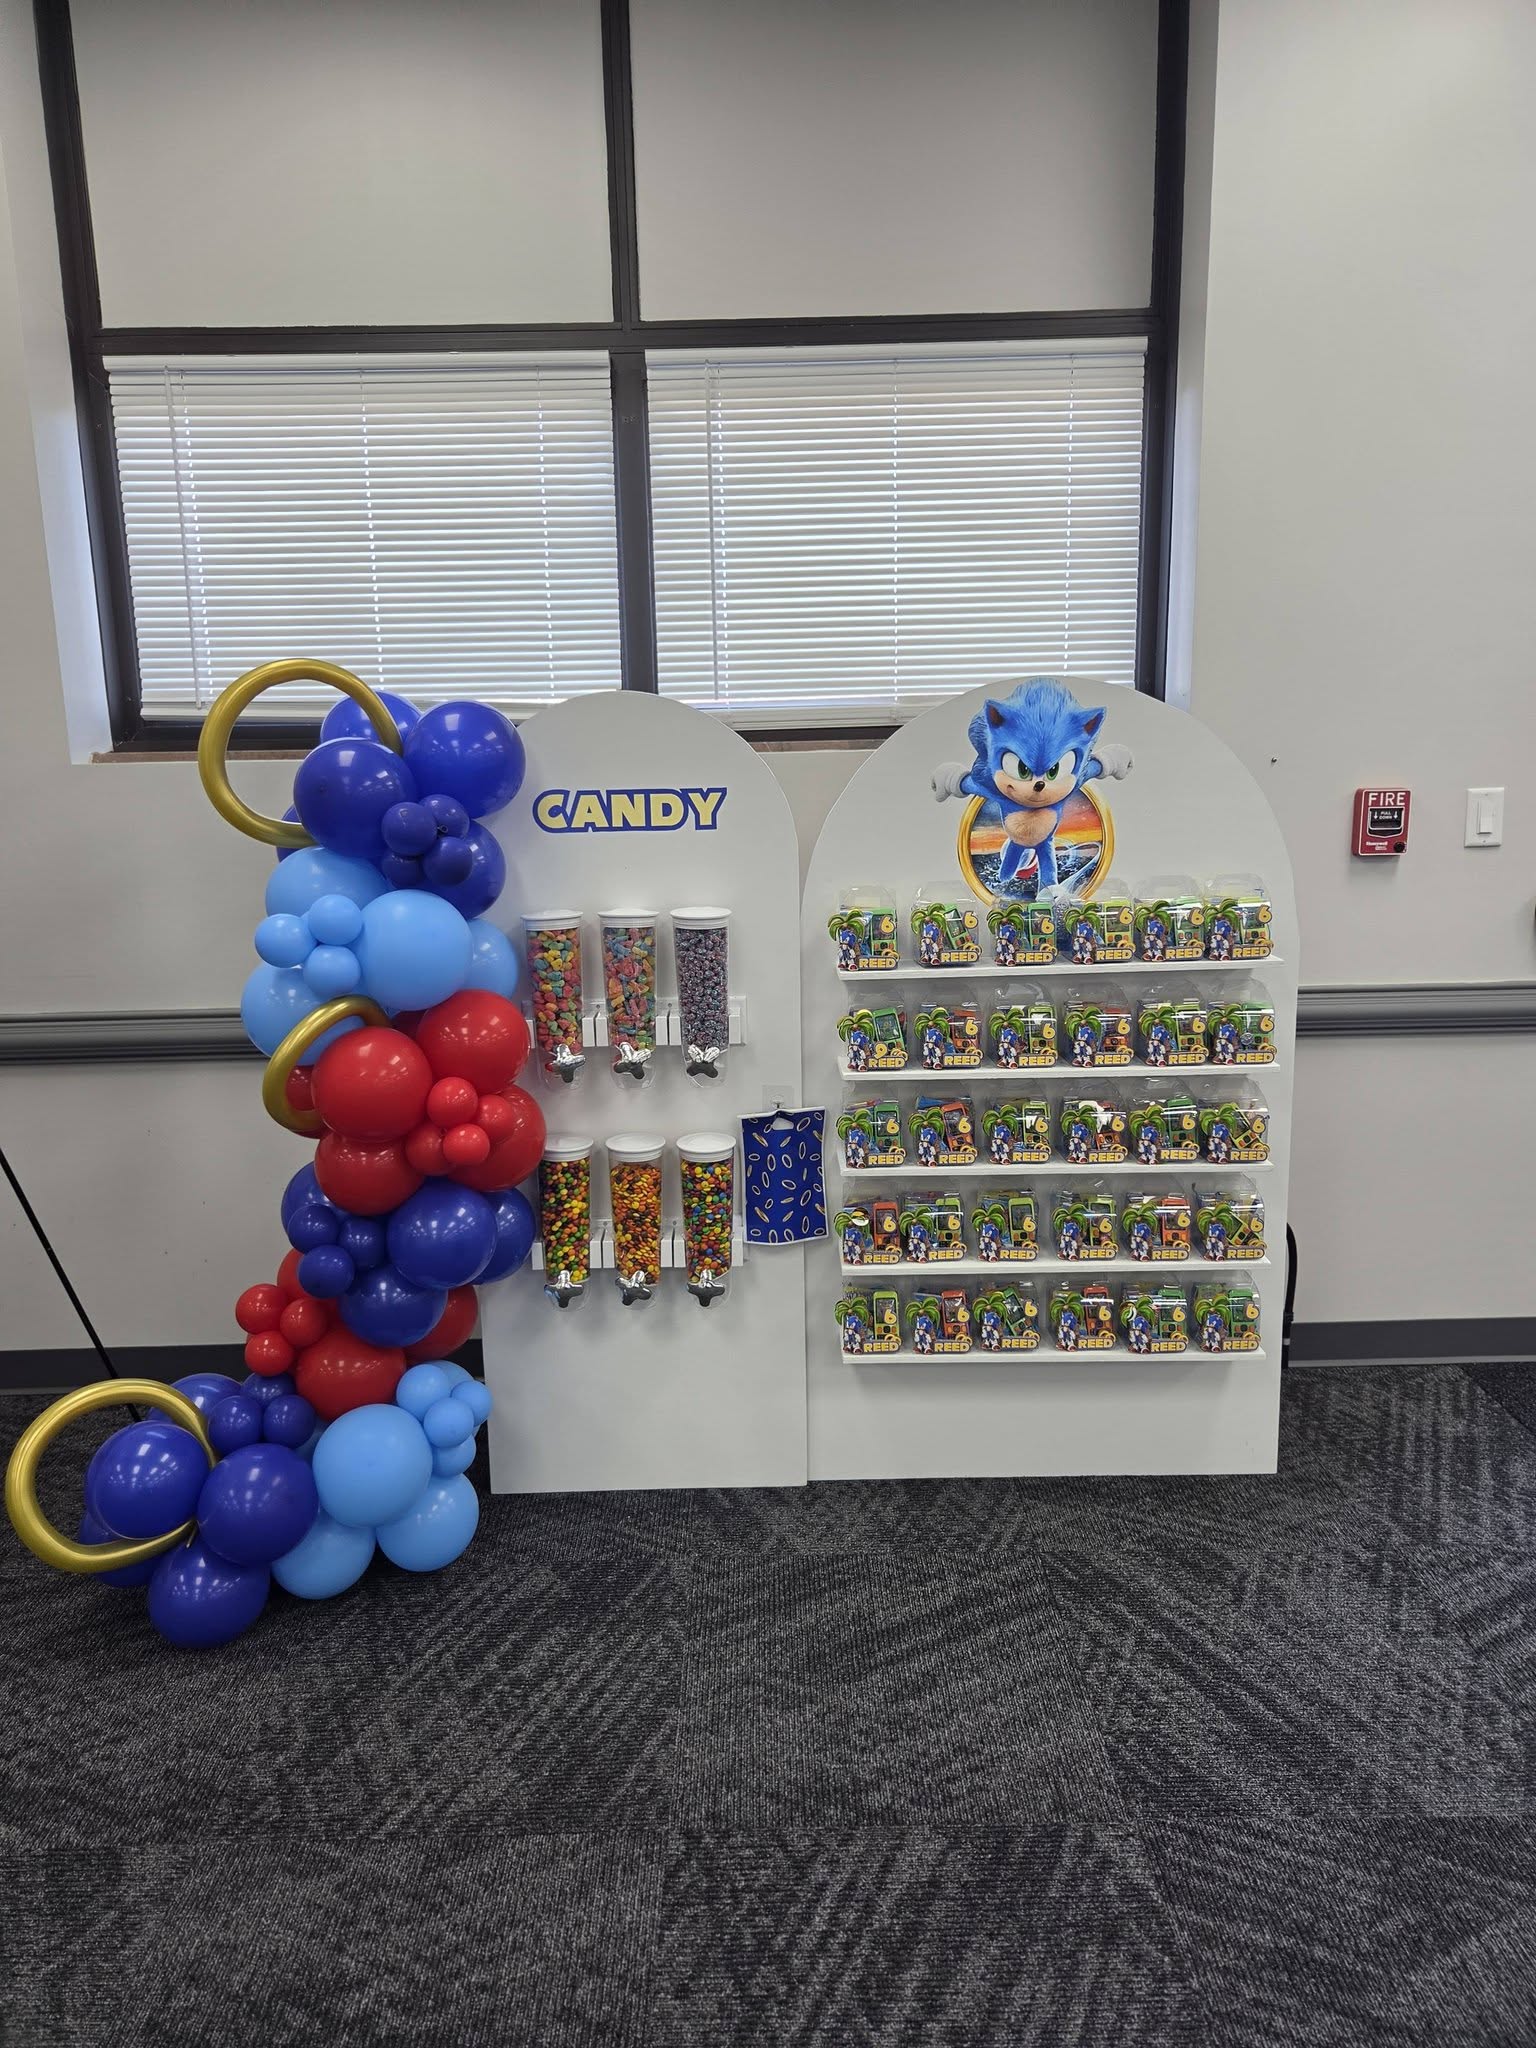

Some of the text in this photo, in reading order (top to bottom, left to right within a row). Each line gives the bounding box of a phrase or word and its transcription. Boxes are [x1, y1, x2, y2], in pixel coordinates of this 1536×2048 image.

[1368, 792, 1406, 806] FIRE
[532, 787, 727, 833] CANDY
[964, 912, 978, 928] 6
[1119, 907, 1133, 924] 6
[1192, 909, 1204, 925] 6
[1259, 906, 1272, 924] 6
[881, 916, 895, 933] 6
[1041, 917, 1054, 934] 6
[941, 952, 977, 963] REED
[1016, 952, 1052, 964] REED
[1095, 950, 1132, 961] REED
[1166, 947, 1202, 959] REED
[1233, 946, 1270, 957] REED
[859, 958, 895, 969] REED
[966, 1018, 978, 1035] 6
[1043, 1022, 1056, 1039] 6
[1117, 1019, 1130, 1036] 6
[1193, 1017, 1205, 1034] 6
[1262, 1015, 1274, 1032] 6
[869, 1057, 905, 1069] REED
[944, 1054, 979, 1066] REED
[1019, 1055, 1055, 1066] REED
[1095, 1054, 1131, 1065] REED
[1169, 1053, 1205, 1064] REED
[1237, 1052, 1273, 1064] REED
[887, 1117, 900, 1134] 6
[958, 1116, 971, 1132] 6
[1035, 1115, 1048, 1132] 6
[1112, 1114, 1124, 1131] 6
[1183, 1114, 1195, 1130] 6
[1252, 1115, 1266, 1132] 6
[869, 1153, 904, 1166] REED
[939, 1152, 974, 1165] REED
[1013, 1150, 1048, 1162] REED
[1089, 1150, 1124, 1162] REED
[1160, 1148, 1196, 1160] REED
[1231, 1150, 1266, 1162] REED
[884, 1215, 896, 1232] 6
[948, 1213, 961, 1230] 6
[1023, 1214, 1035, 1231] 6
[1098, 1216, 1111, 1232] 6
[1177, 1210, 1190, 1227] 6
[1250, 1216, 1263, 1232] 6
[864, 1251, 900, 1264] REED
[928, 1248, 964, 1260] REED
[1000, 1248, 1036, 1260] REED
[1080, 1247, 1116, 1259] REED
[1153, 1249, 1188, 1260] REED
[1227, 1248, 1263, 1259] REED
[884, 1306, 896, 1323] 6
[957, 1305, 969, 1322] 6
[1025, 1299, 1038, 1317] 6
[1099, 1304, 1111, 1321] 6
[1173, 1305, 1185, 1322] 6
[1247, 1301, 1259, 1318] 6
[864, 1341, 900, 1353] REED
[934, 1340, 970, 1352] REED
[1002, 1337, 1036, 1349] REED
[1078, 1337, 1113, 1349] REED
[1150, 1340, 1186, 1352] REED
[1224, 1338, 1258, 1350] REED
